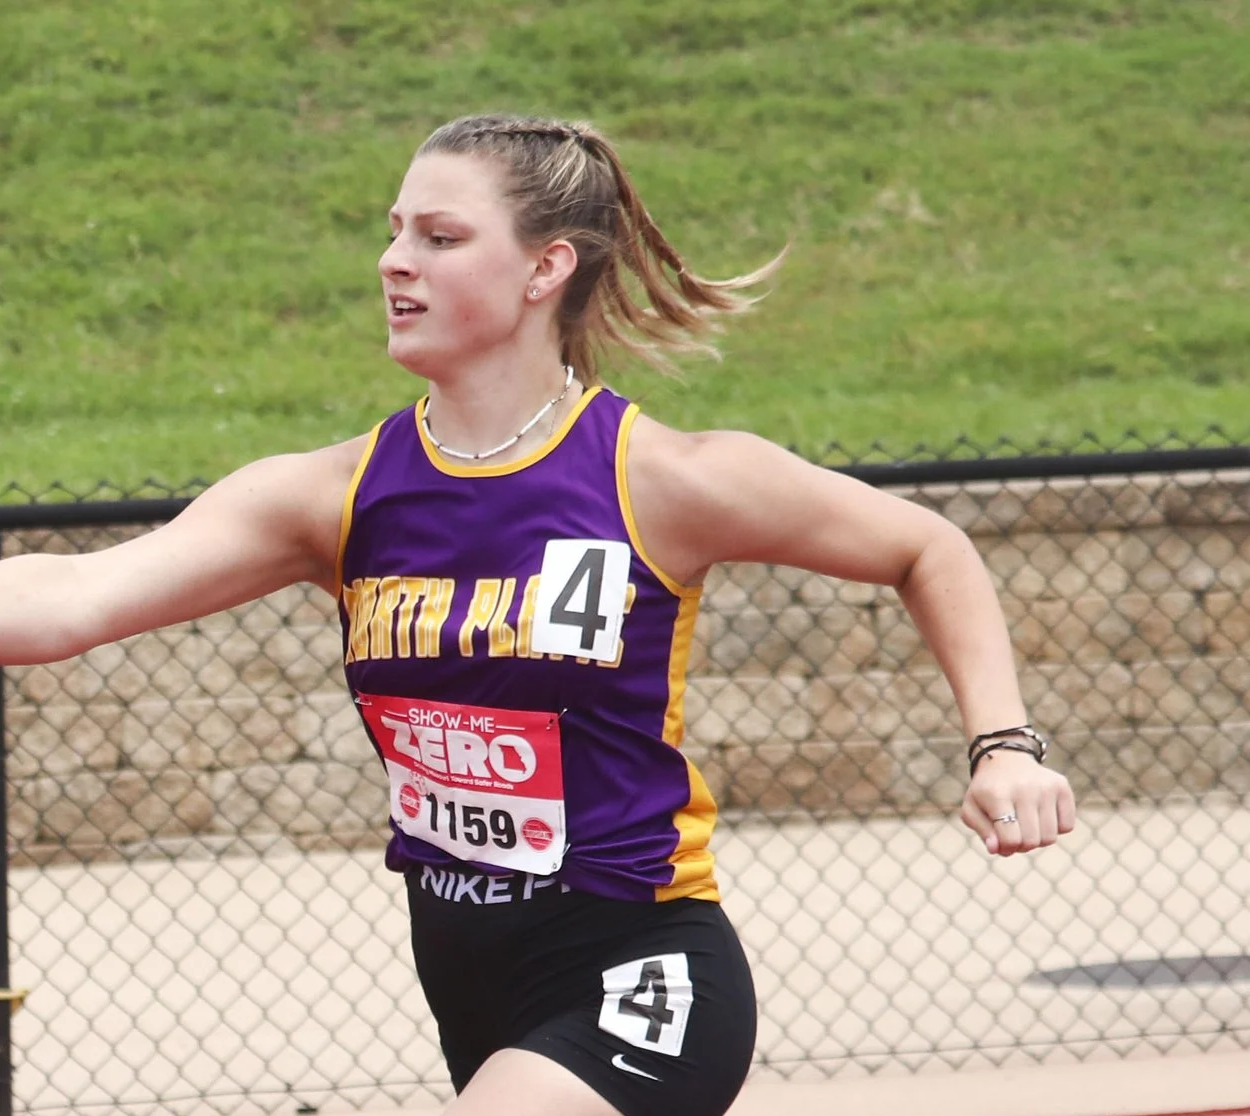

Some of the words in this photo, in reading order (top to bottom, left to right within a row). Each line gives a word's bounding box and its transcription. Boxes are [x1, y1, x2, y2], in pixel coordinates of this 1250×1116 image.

[342, 575, 456, 666] NORTH
[549, 548, 607, 651] 4
[380, 715, 537, 783] ZERO
[407, 707, 496, 733] SHOW-ME
[450, 775, 474, 785] Toward
[474, 778, 493, 788] Safer
[493, 780, 514, 791] Roads
[424, 792, 518, 850] 1159
[420, 865, 515, 905] NIKE
[616, 959, 675, 1044] 4
